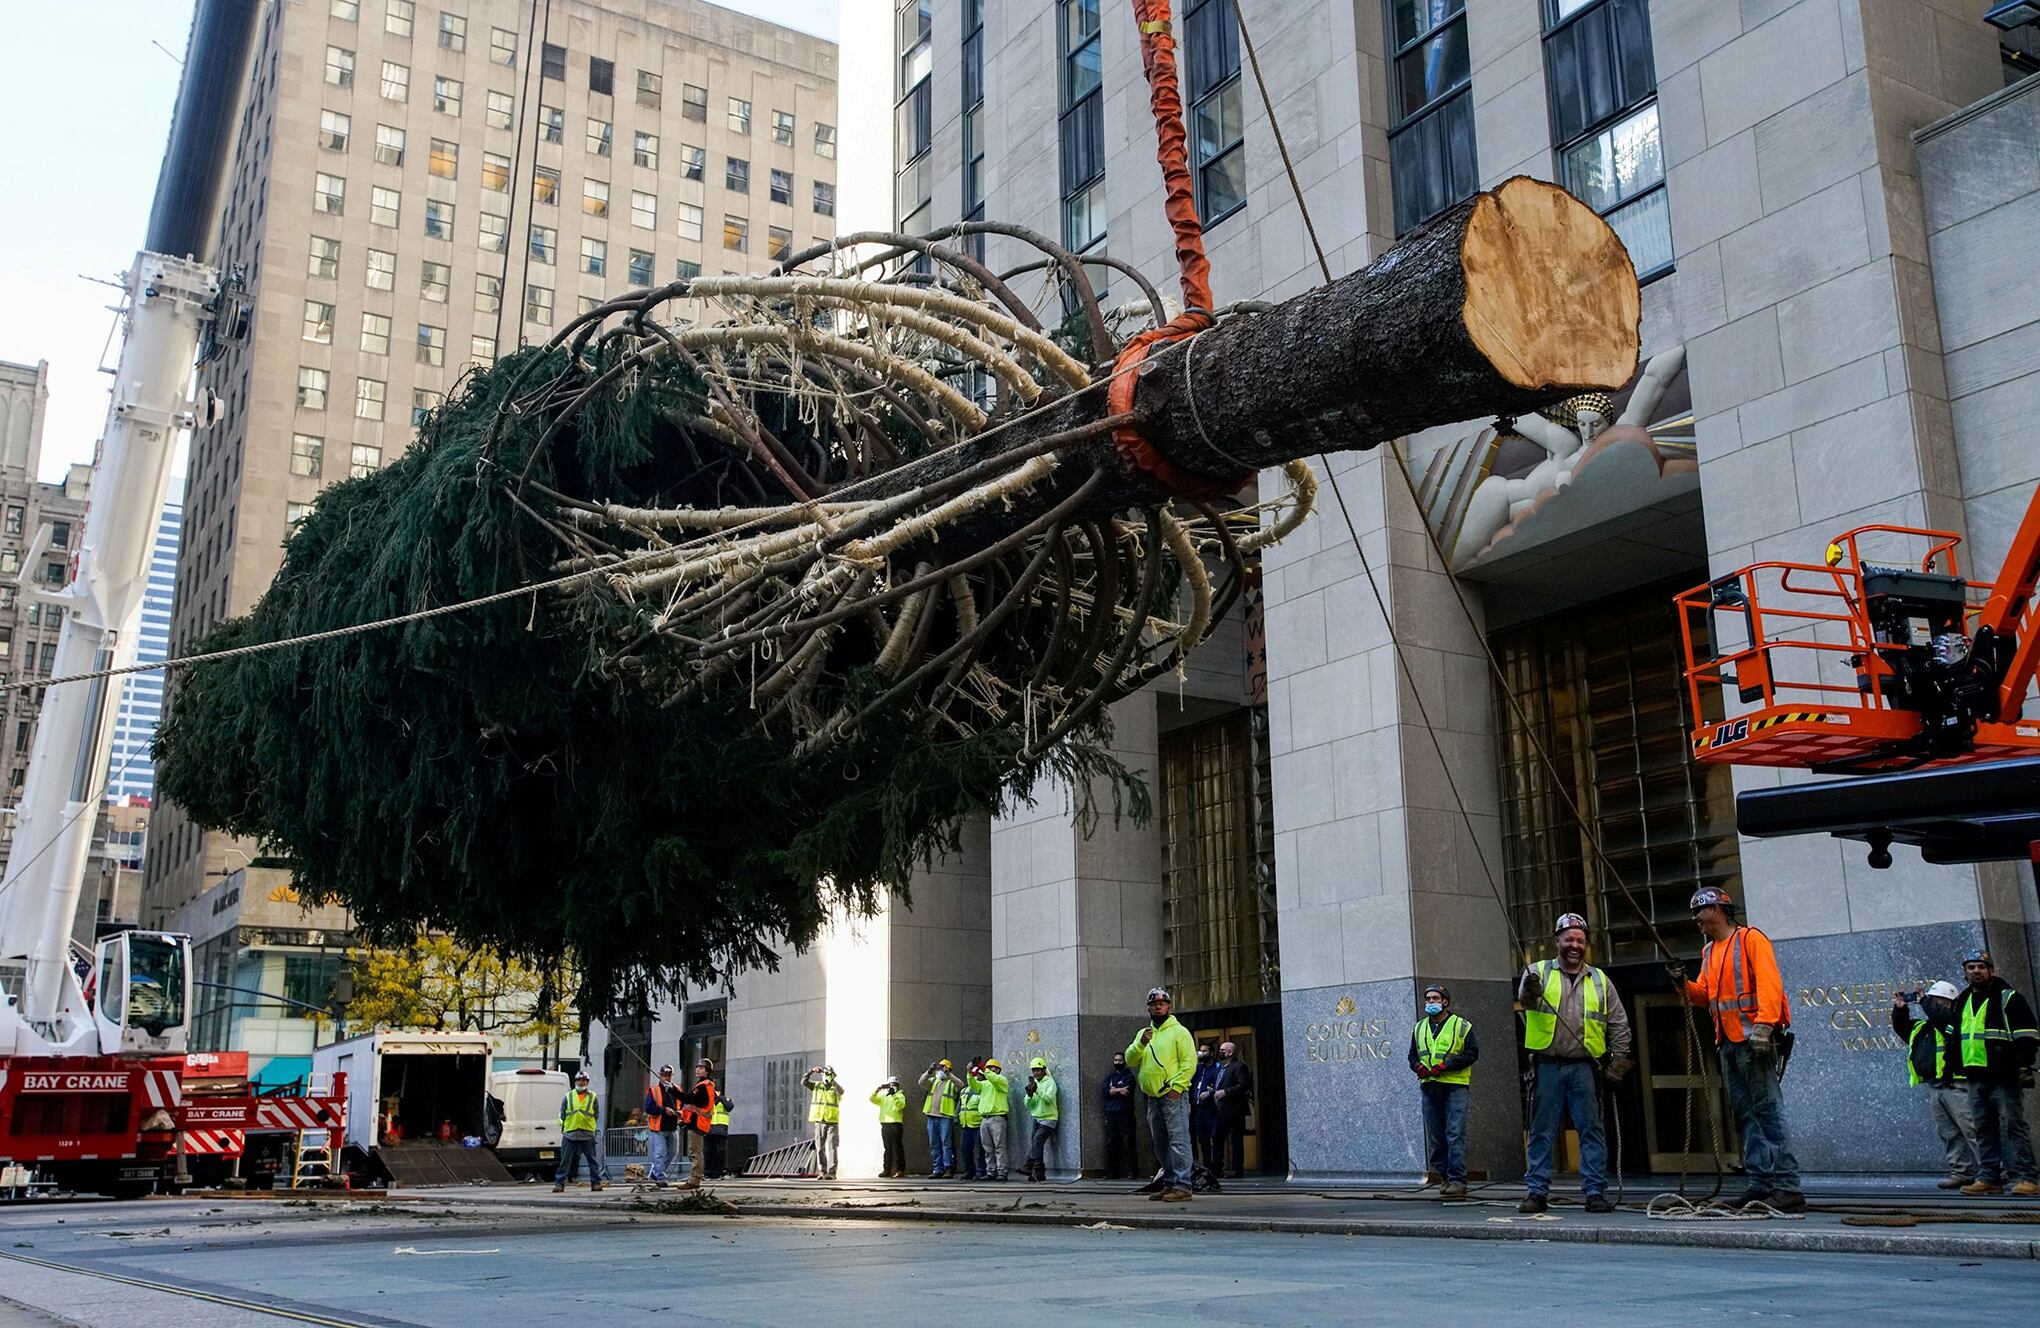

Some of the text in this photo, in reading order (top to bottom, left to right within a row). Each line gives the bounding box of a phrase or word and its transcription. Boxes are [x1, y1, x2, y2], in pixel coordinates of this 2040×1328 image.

[1710, 717, 1750, 749] JLG
[1306, 1018, 1388, 1042] COMCAST
[1308, 1040, 1392, 1062] BUILDING
[24, 1076, 128, 1088] BAY CRANE
[188, 1110, 245, 1118] BAY CRANE
